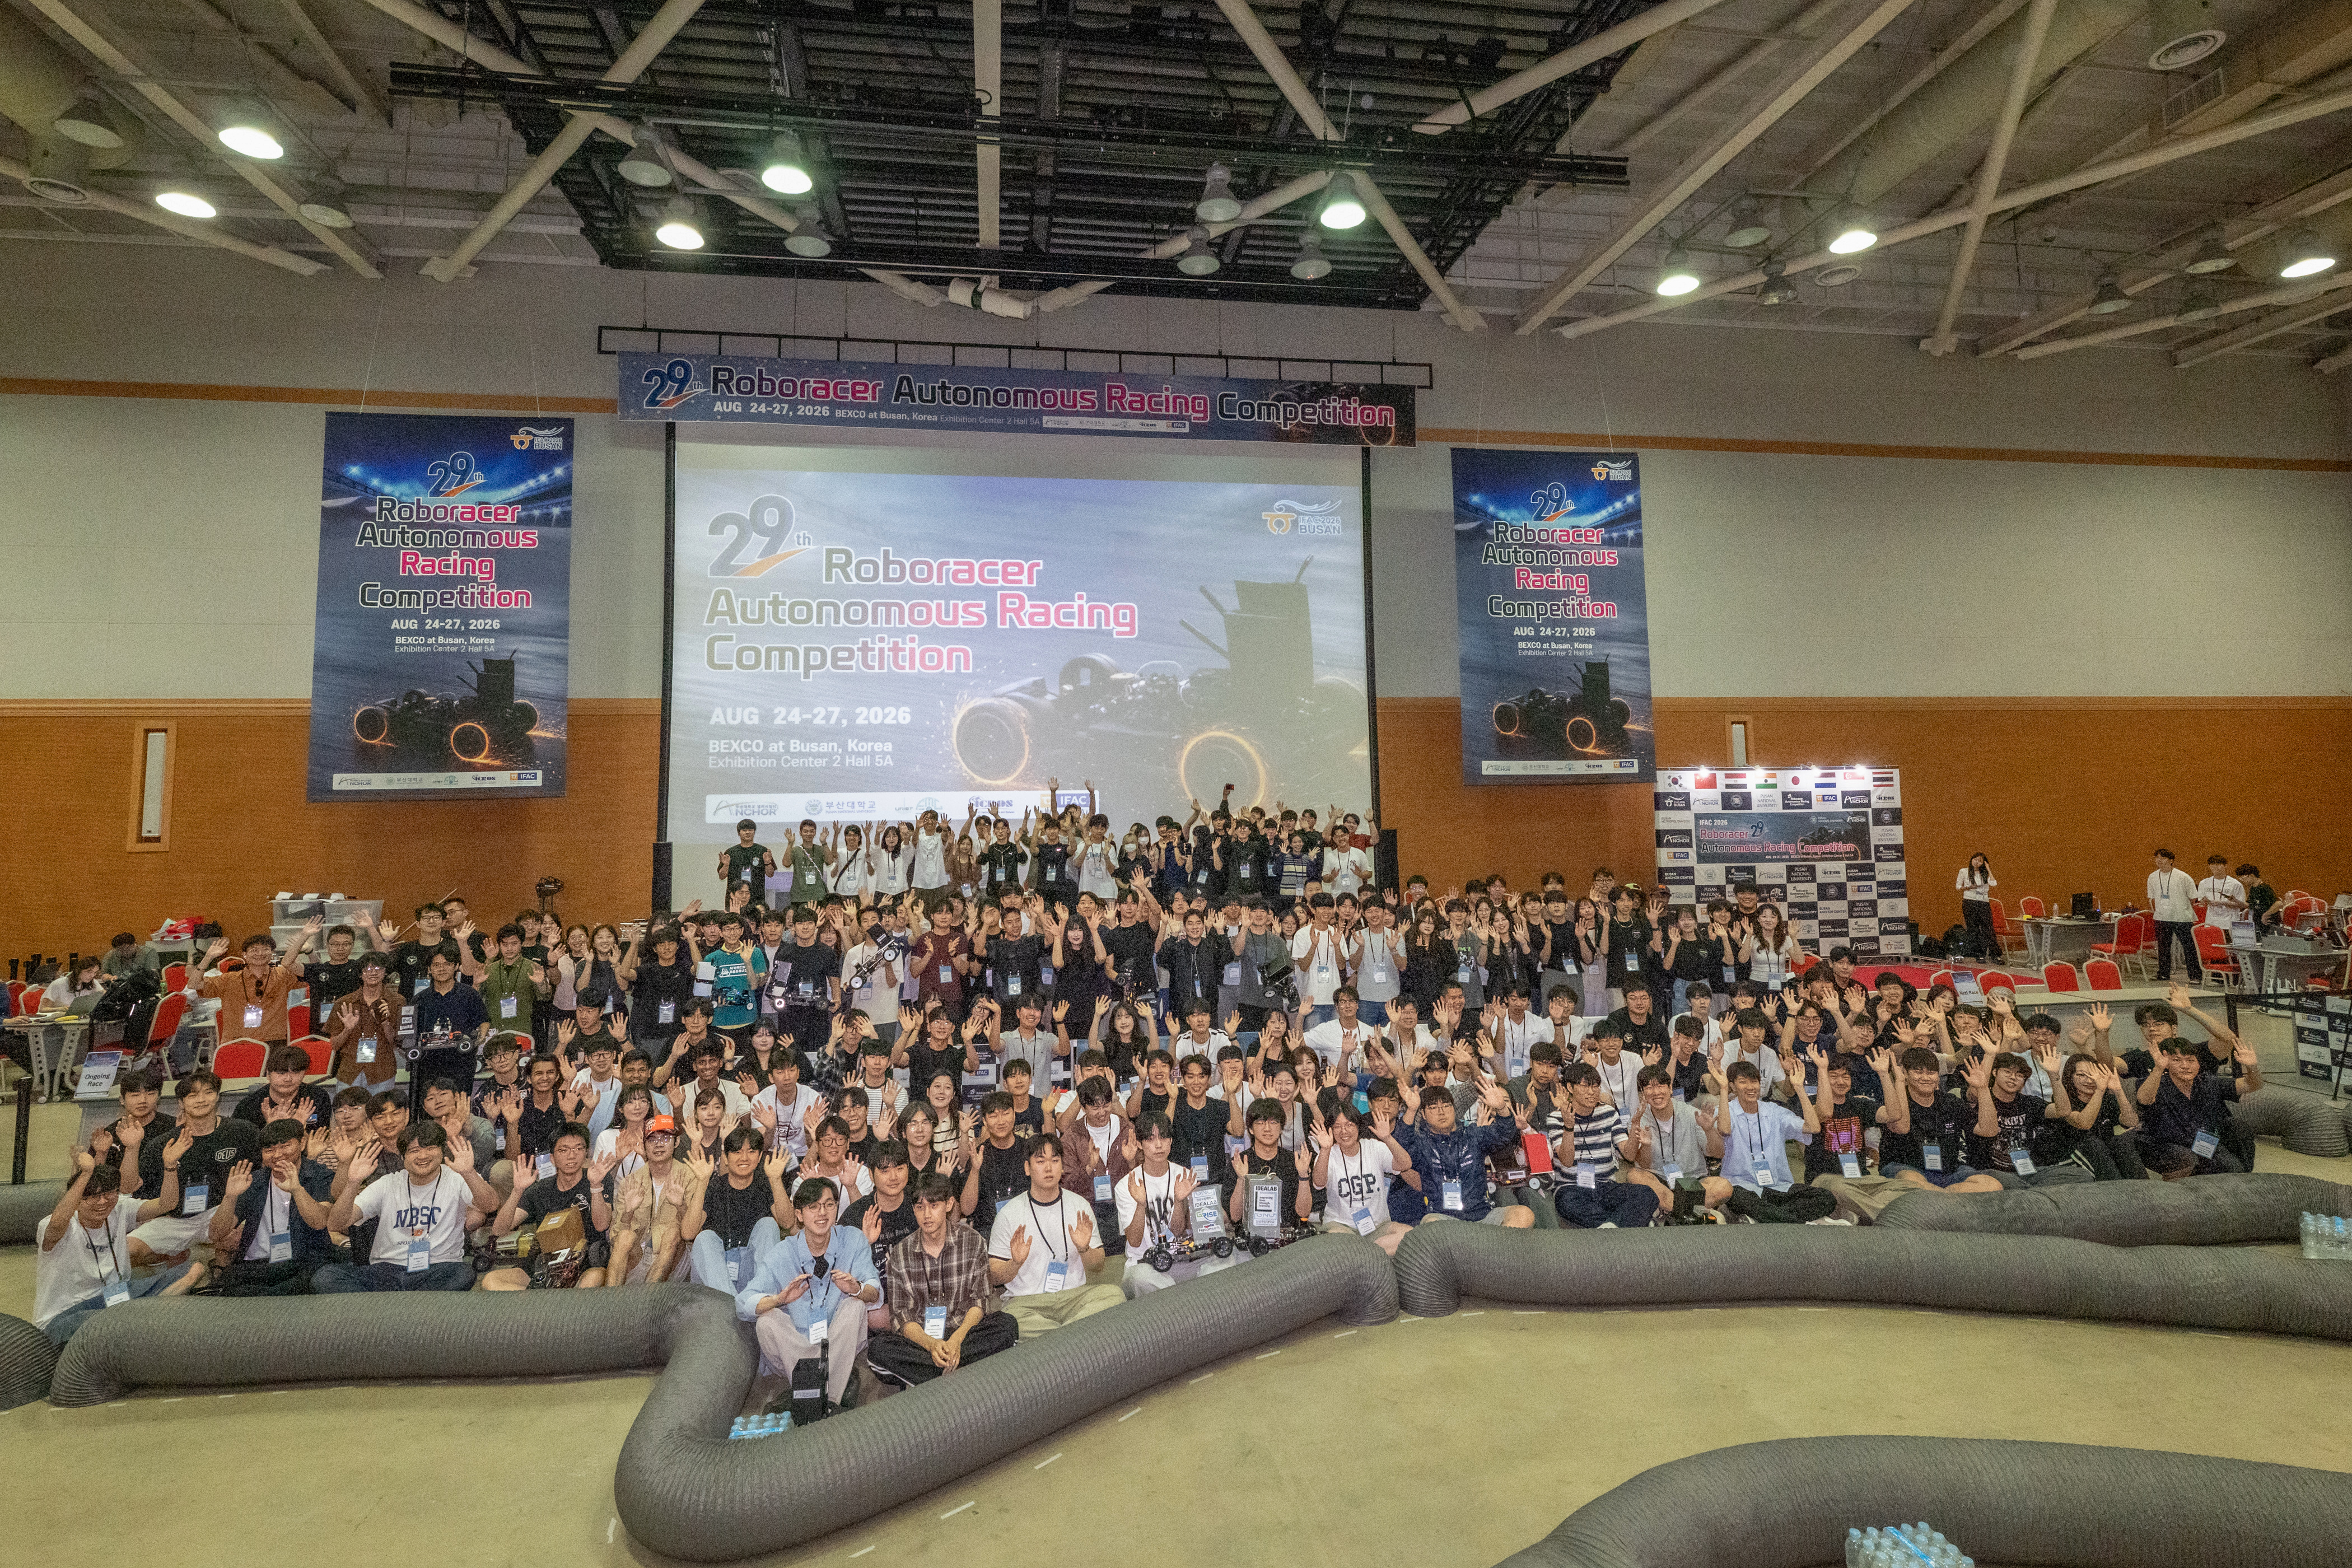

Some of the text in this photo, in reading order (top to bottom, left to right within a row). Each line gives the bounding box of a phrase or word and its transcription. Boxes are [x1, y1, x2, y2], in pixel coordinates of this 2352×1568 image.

[710, 365, 1396, 430] Roboracer Autonomous Racing Competition
[713, 401, 742, 413] AUG
[750, 402, 792, 416] 24-27,
[797, 404, 830, 417] 2026
[835, 409, 866, 419] BEXCO
[868, 410, 878, 419] at
[880, 410, 909, 421] Busan,
[912, 412, 938, 421] Korea
[940, 414, 977, 423] Exhibition
[979, 416, 1004, 424] Center
[376, 496, 521, 523] Roboracer
[356, 521, 538, 548] Autonomous
[1299, 524, 1341, 535] BUSAN
[1494, 521, 1604, 544] Roboracer
[1482, 542, 1618, 566] Autonomous
[400, 550, 495, 582] Racing
[823, 545, 1043, 587] Roboracer
[1515, 567, 1589, 595] Racing
[359, 581, 532, 614] Competition
[1487, 595, 1617, 622] Competition
[703, 587, 1138, 638] Autonomous Racing
[391, 619, 500, 632] AUG 24-27, 2026
[1514, 627, 1595, 637] AUG 24-27, 2026
[438, 636, 467, 645] Busan,
[470, 636, 494, 645] Korea
[705, 633, 973, 681] Competition
[710, 706, 911, 727] AUG 24-27, 2026
[709, 739, 893, 755] BEXCO at Busan, Korea
[709, 755, 894, 768] Exhibition Center 2 Hall 5A
[825, 801, 876, 810] 부산대학교
[1060, 796, 1087, 805] IFAC
[1844, 795, 1869, 804] ANCHOR
[1664, 834, 1690, 843] ANCHOR
[1700, 828, 1749, 839] Roboracer
[1701, 841, 1854, 855] Autonomous Racing Competition
[218, 1150, 235, 1160] DEUS
[393, 1206, 441, 1229] NBSC
